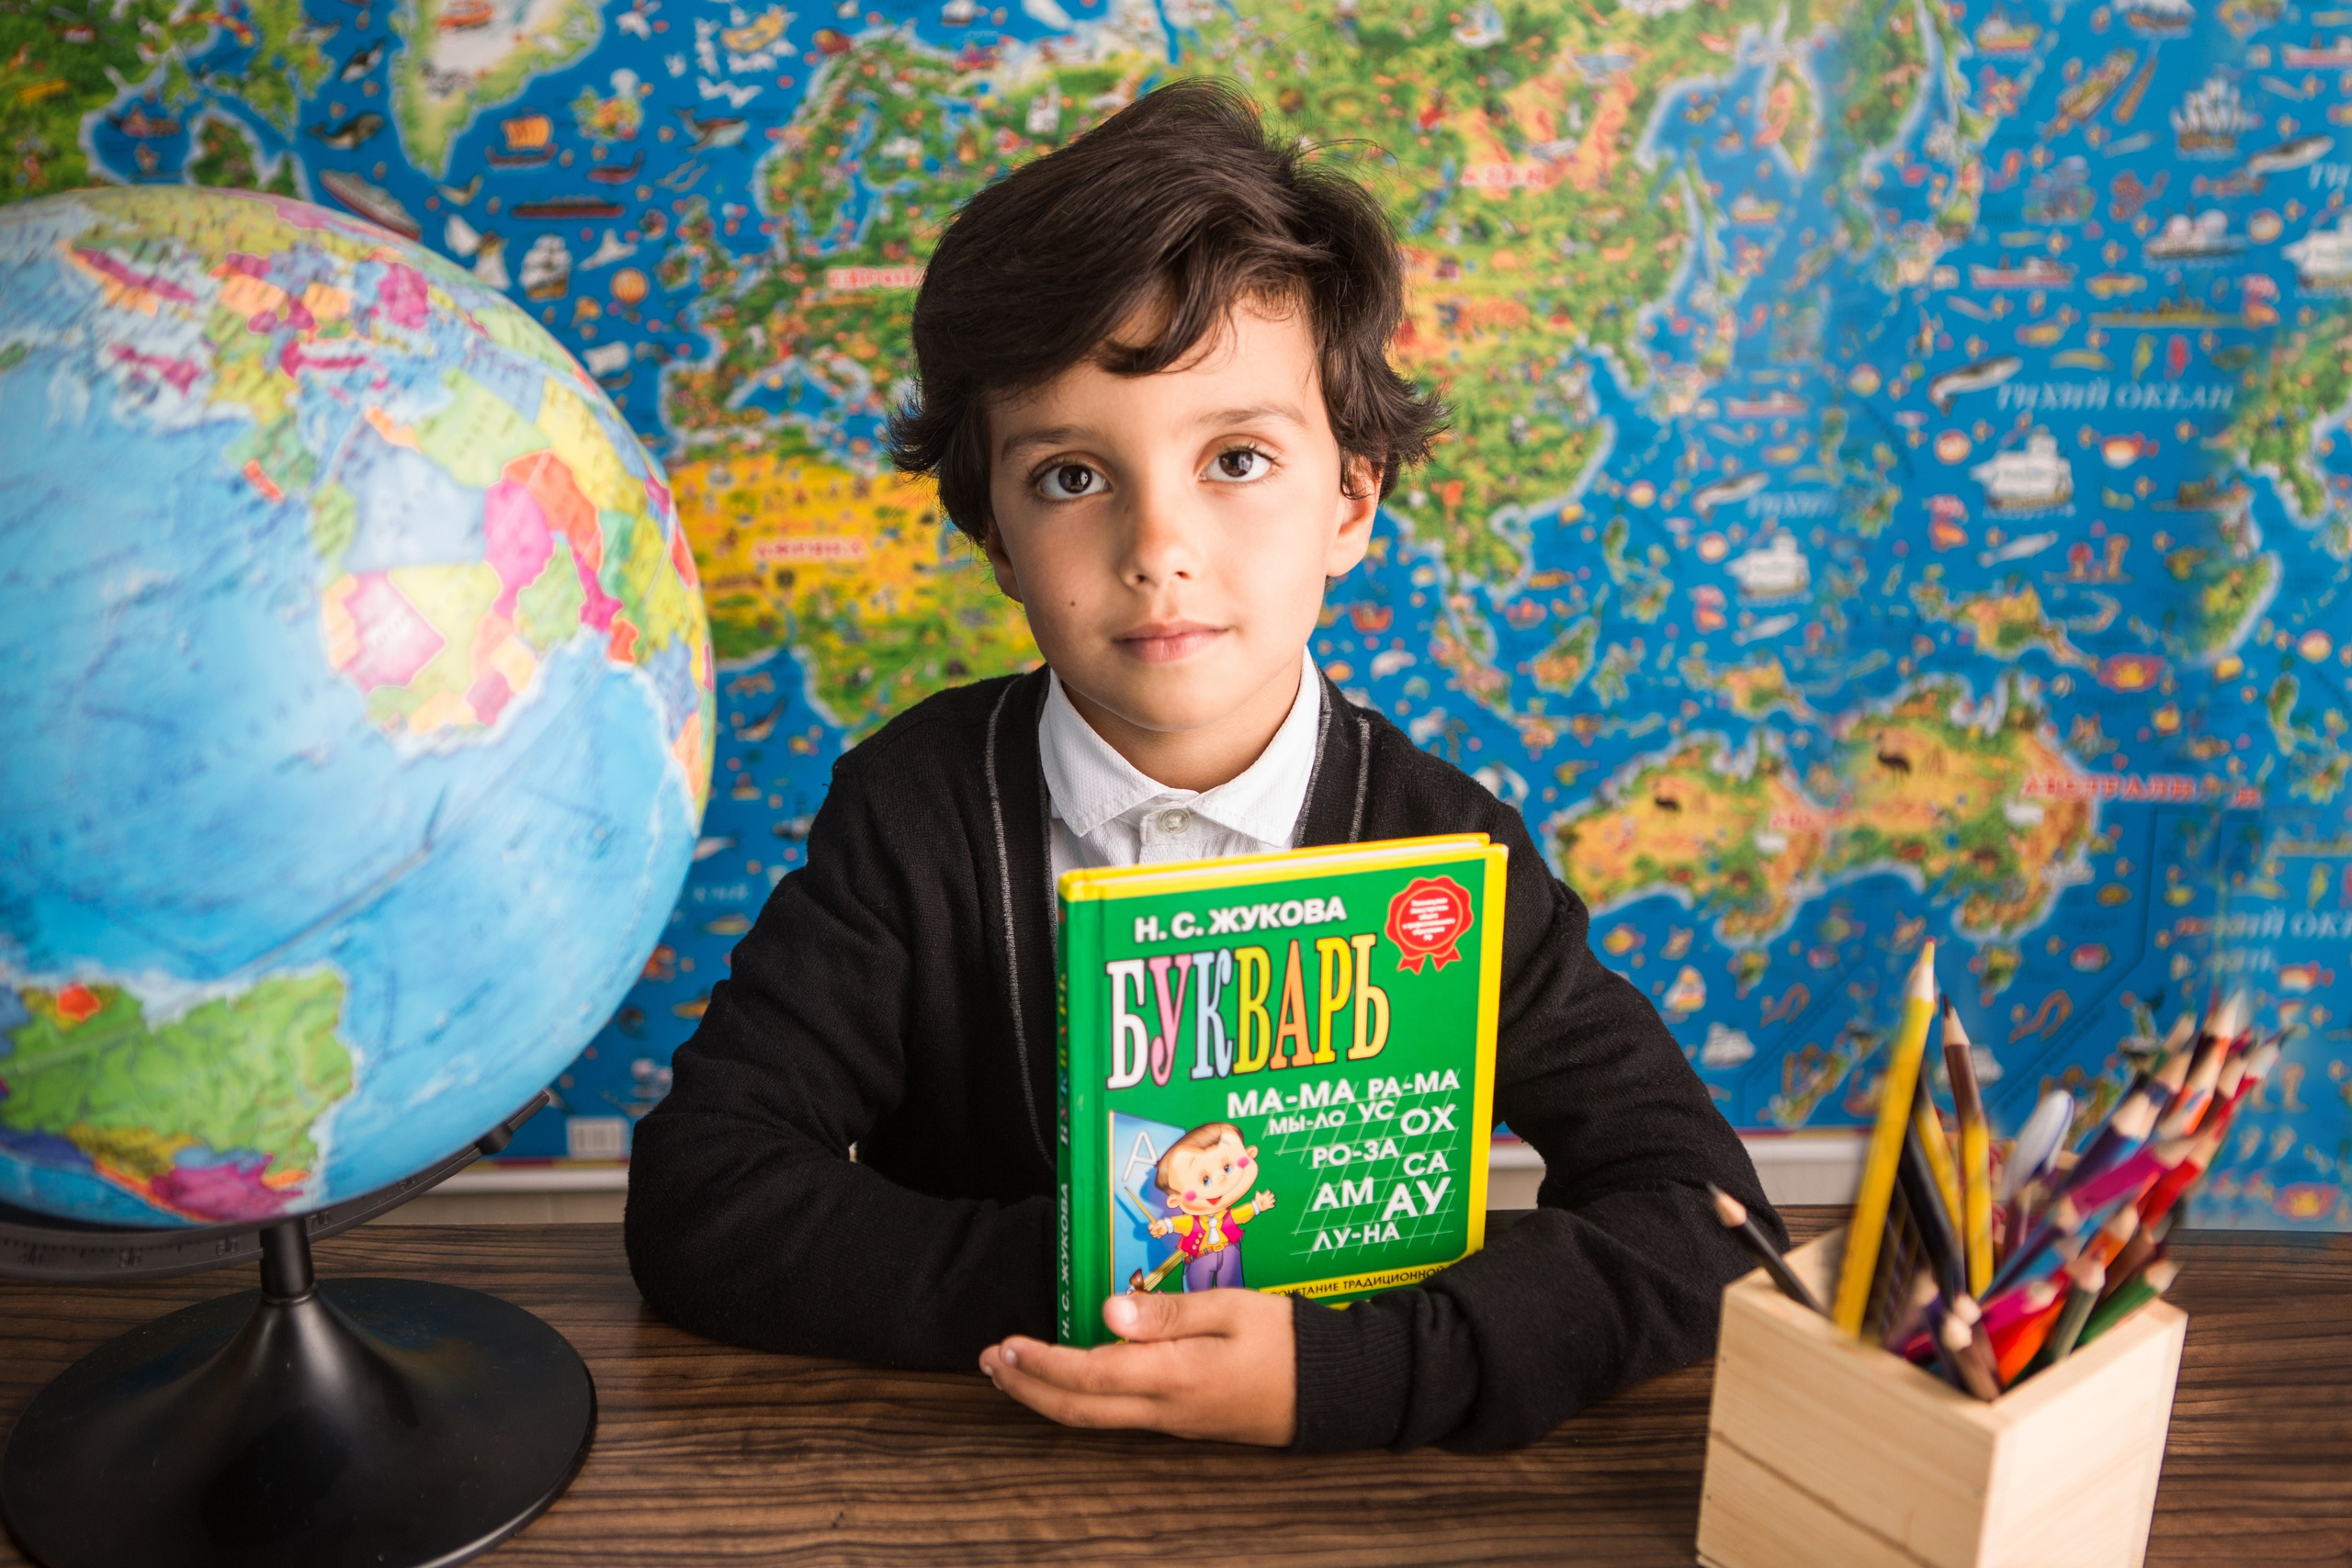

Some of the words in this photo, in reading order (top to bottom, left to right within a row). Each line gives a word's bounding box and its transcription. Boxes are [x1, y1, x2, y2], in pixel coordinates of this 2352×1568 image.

[1134, 916, 1167, 943] Н.
[1171, 909, 1204, 938] С.
[1208, 896, 1347, 935] ЖУКОВА
[1105, 933, 1391, 1090] БУКВАРЬ
[1227, 1077, 1356, 1119] МА-МА
[1368, 1068, 1461, 1100] РА-МА
[1269, 1110, 1346, 1135] МЫ-ЛО
[1357, 1100, 1396, 1122] УС
[1399, 1103, 1456, 1136] ОХ
[1312, 1137, 1400, 1168] РО-ЗА
[1403, 1150, 1449, 1177] СА
[1312, 1176, 1374, 1212] АМ
[1381, 1176, 1453, 1222] АУ
[1060, 1182, 1069, 1287] ЖУКОВА
[1313, 1221, 1400, 1252] ЛУ-НА
